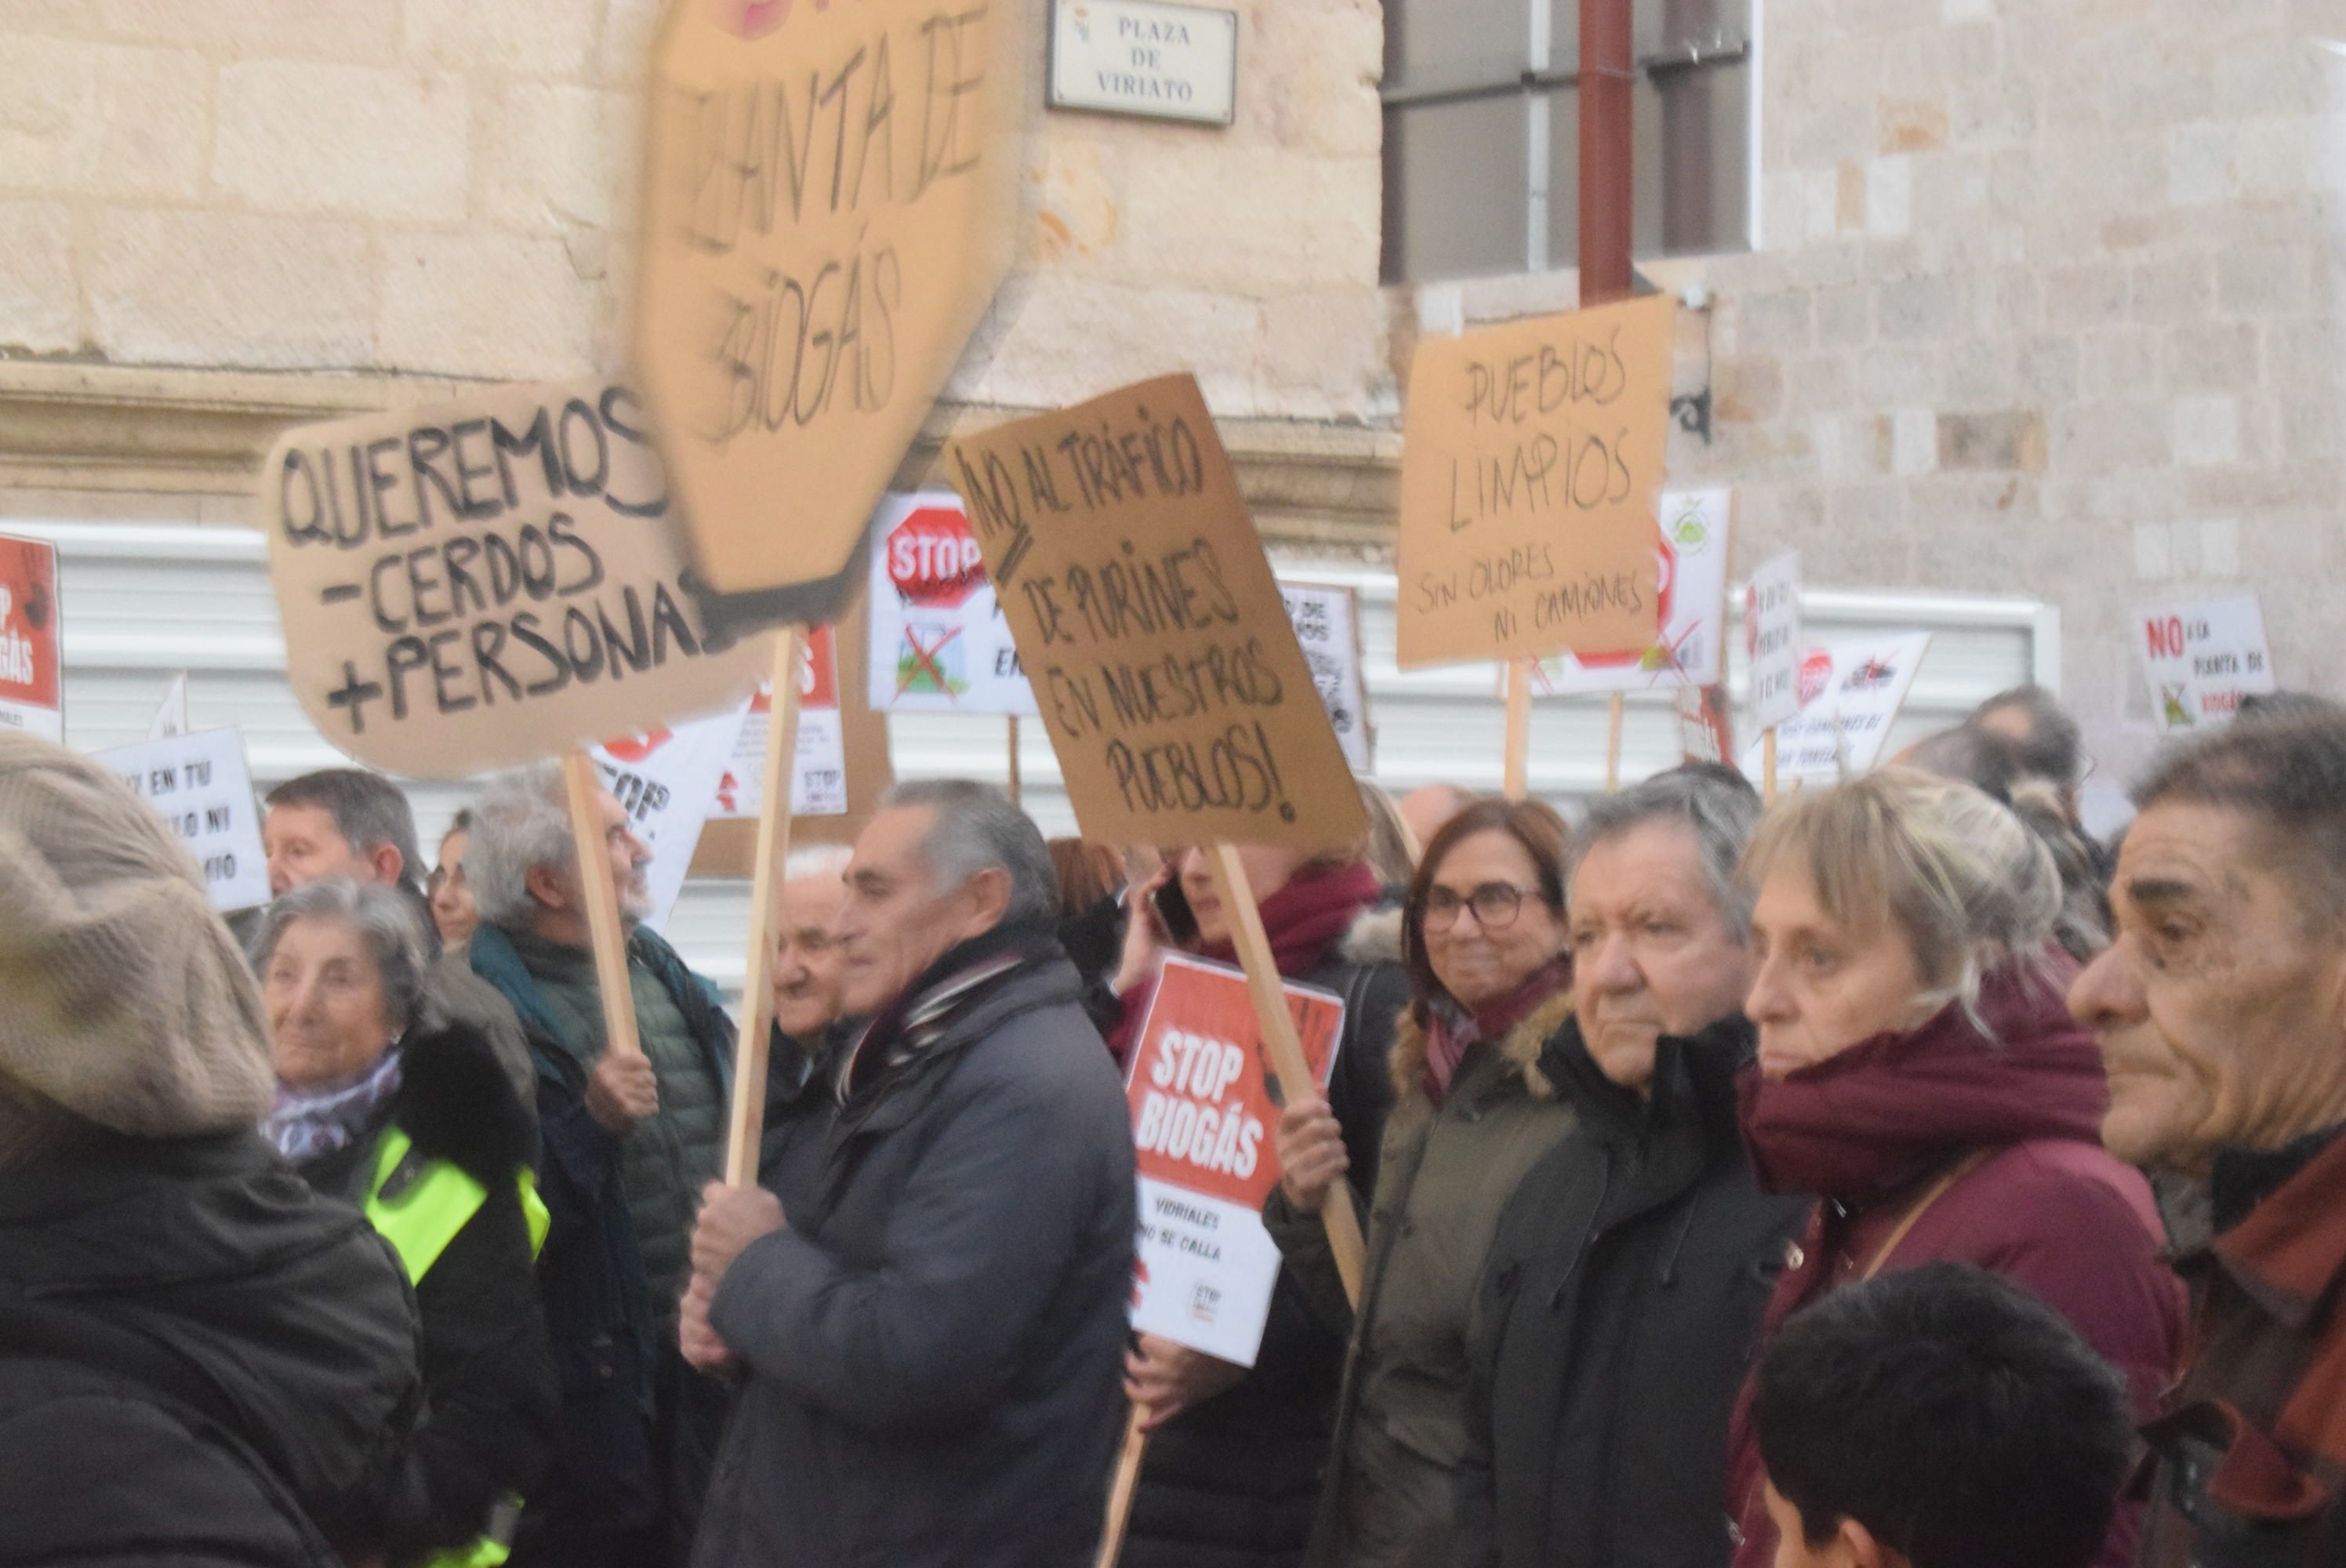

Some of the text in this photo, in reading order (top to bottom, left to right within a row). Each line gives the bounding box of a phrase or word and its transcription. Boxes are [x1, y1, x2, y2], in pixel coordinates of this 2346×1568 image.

[1119, 16, 1190, 45] PLAZA
[1131, 47, 1161, 69] DE
[1098, 71, 1193, 101] VIRIATO
[1464, 323, 1627, 427] PUEBLOS
[281, 386, 669, 548] QUEREMOS
[954, 445, 1022, 538] NO
[1021, 441, 1072, 514] AL
[1448, 427, 1632, 534] LIMPIOS
[891, 534, 982, 581] STOP
[1417, 541, 1556, 617] SIN OLORES
[1022, 575, 1077, 646] DE
[1494, 608, 1519, 644] NI
[2145, 615, 2184, 659] NO
[1046, 665, 1102, 739] EN
[1101, 637, 1284, 731] NUESTROS
[150, 767, 176, 796] EN
[184, 760, 212, 789] TU
[1106, 718, 1298, 825] PUEBLOS!
[207, 806, 231, 835] NI
[1152, 1029, 1244, 1102] STOP
[1136, 1091, 1264, 1179] BIOGÁS
[1155, 1196, 1221, 1231] VIDRIALES
[1160, 1229, 1178, 1246] SE
[1180, 1235, 1221, 1263] CALLA
